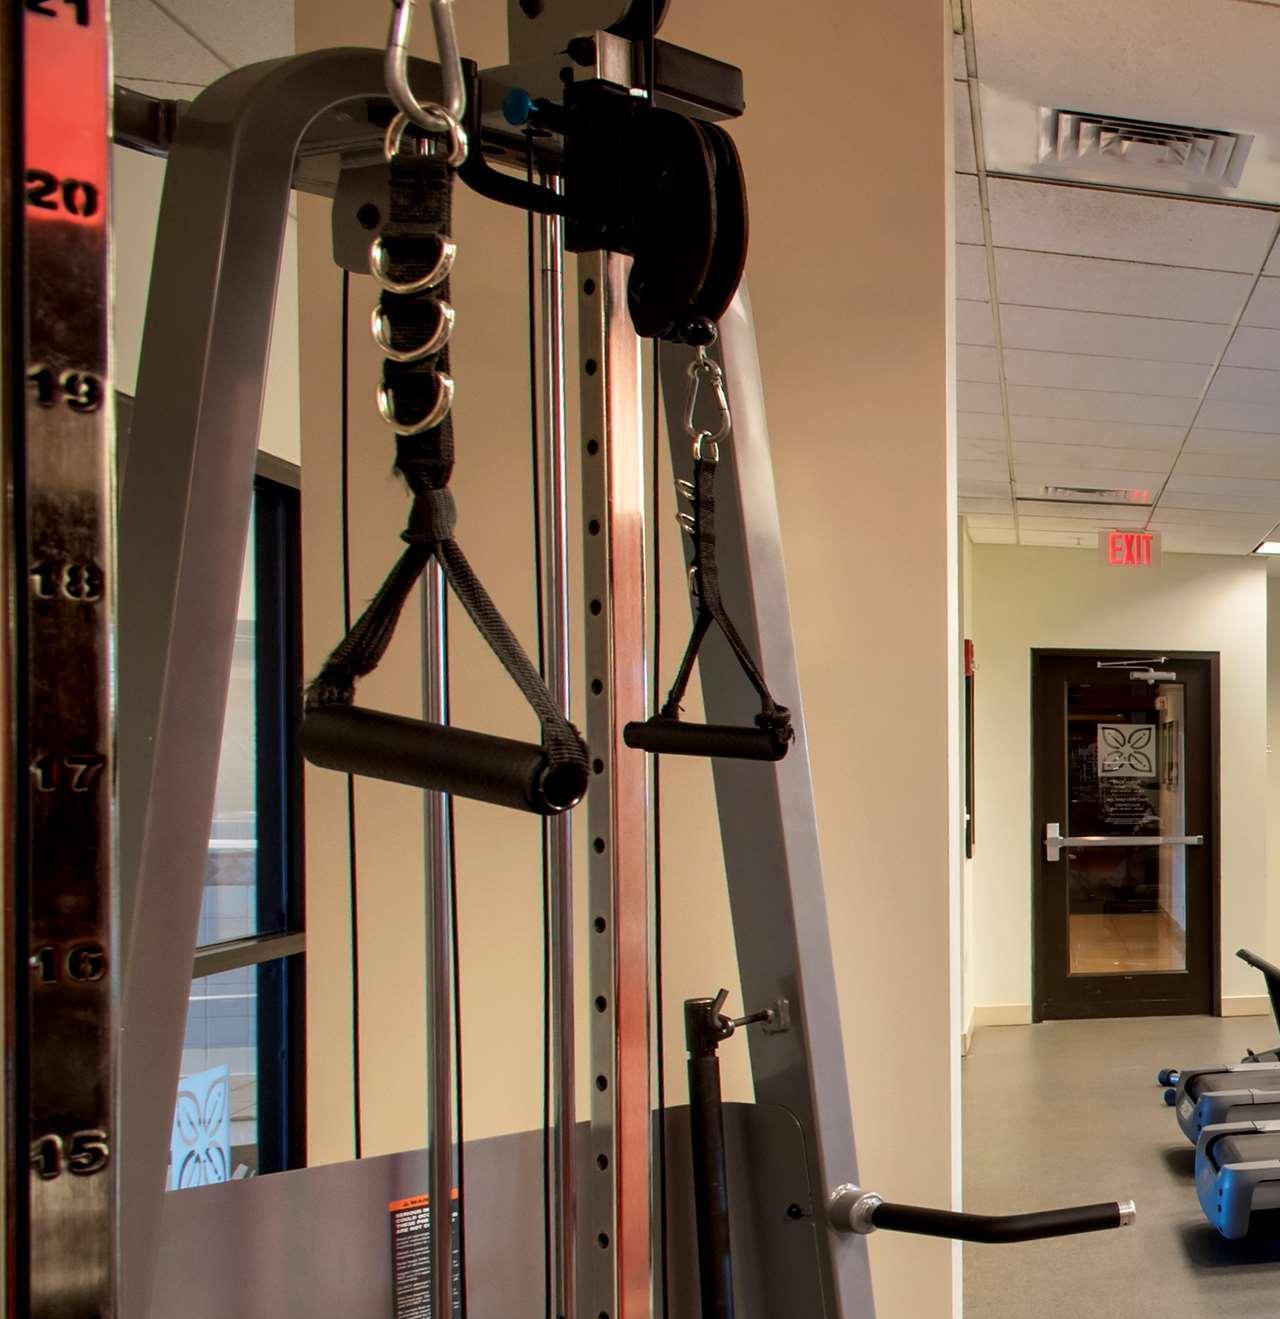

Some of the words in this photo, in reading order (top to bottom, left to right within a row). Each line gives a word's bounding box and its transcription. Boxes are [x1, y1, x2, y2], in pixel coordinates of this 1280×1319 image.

[26, 169, 99, 217] 20
[27, 363, 105, 415] 19
[1109, 532, 1152, 565] EXIT
[29, 560, 105, 601] 18
[30, 754, 106, 792] 17
[30, 945, 106, 984] 16
[31, 1130, 109, 1180] 15
